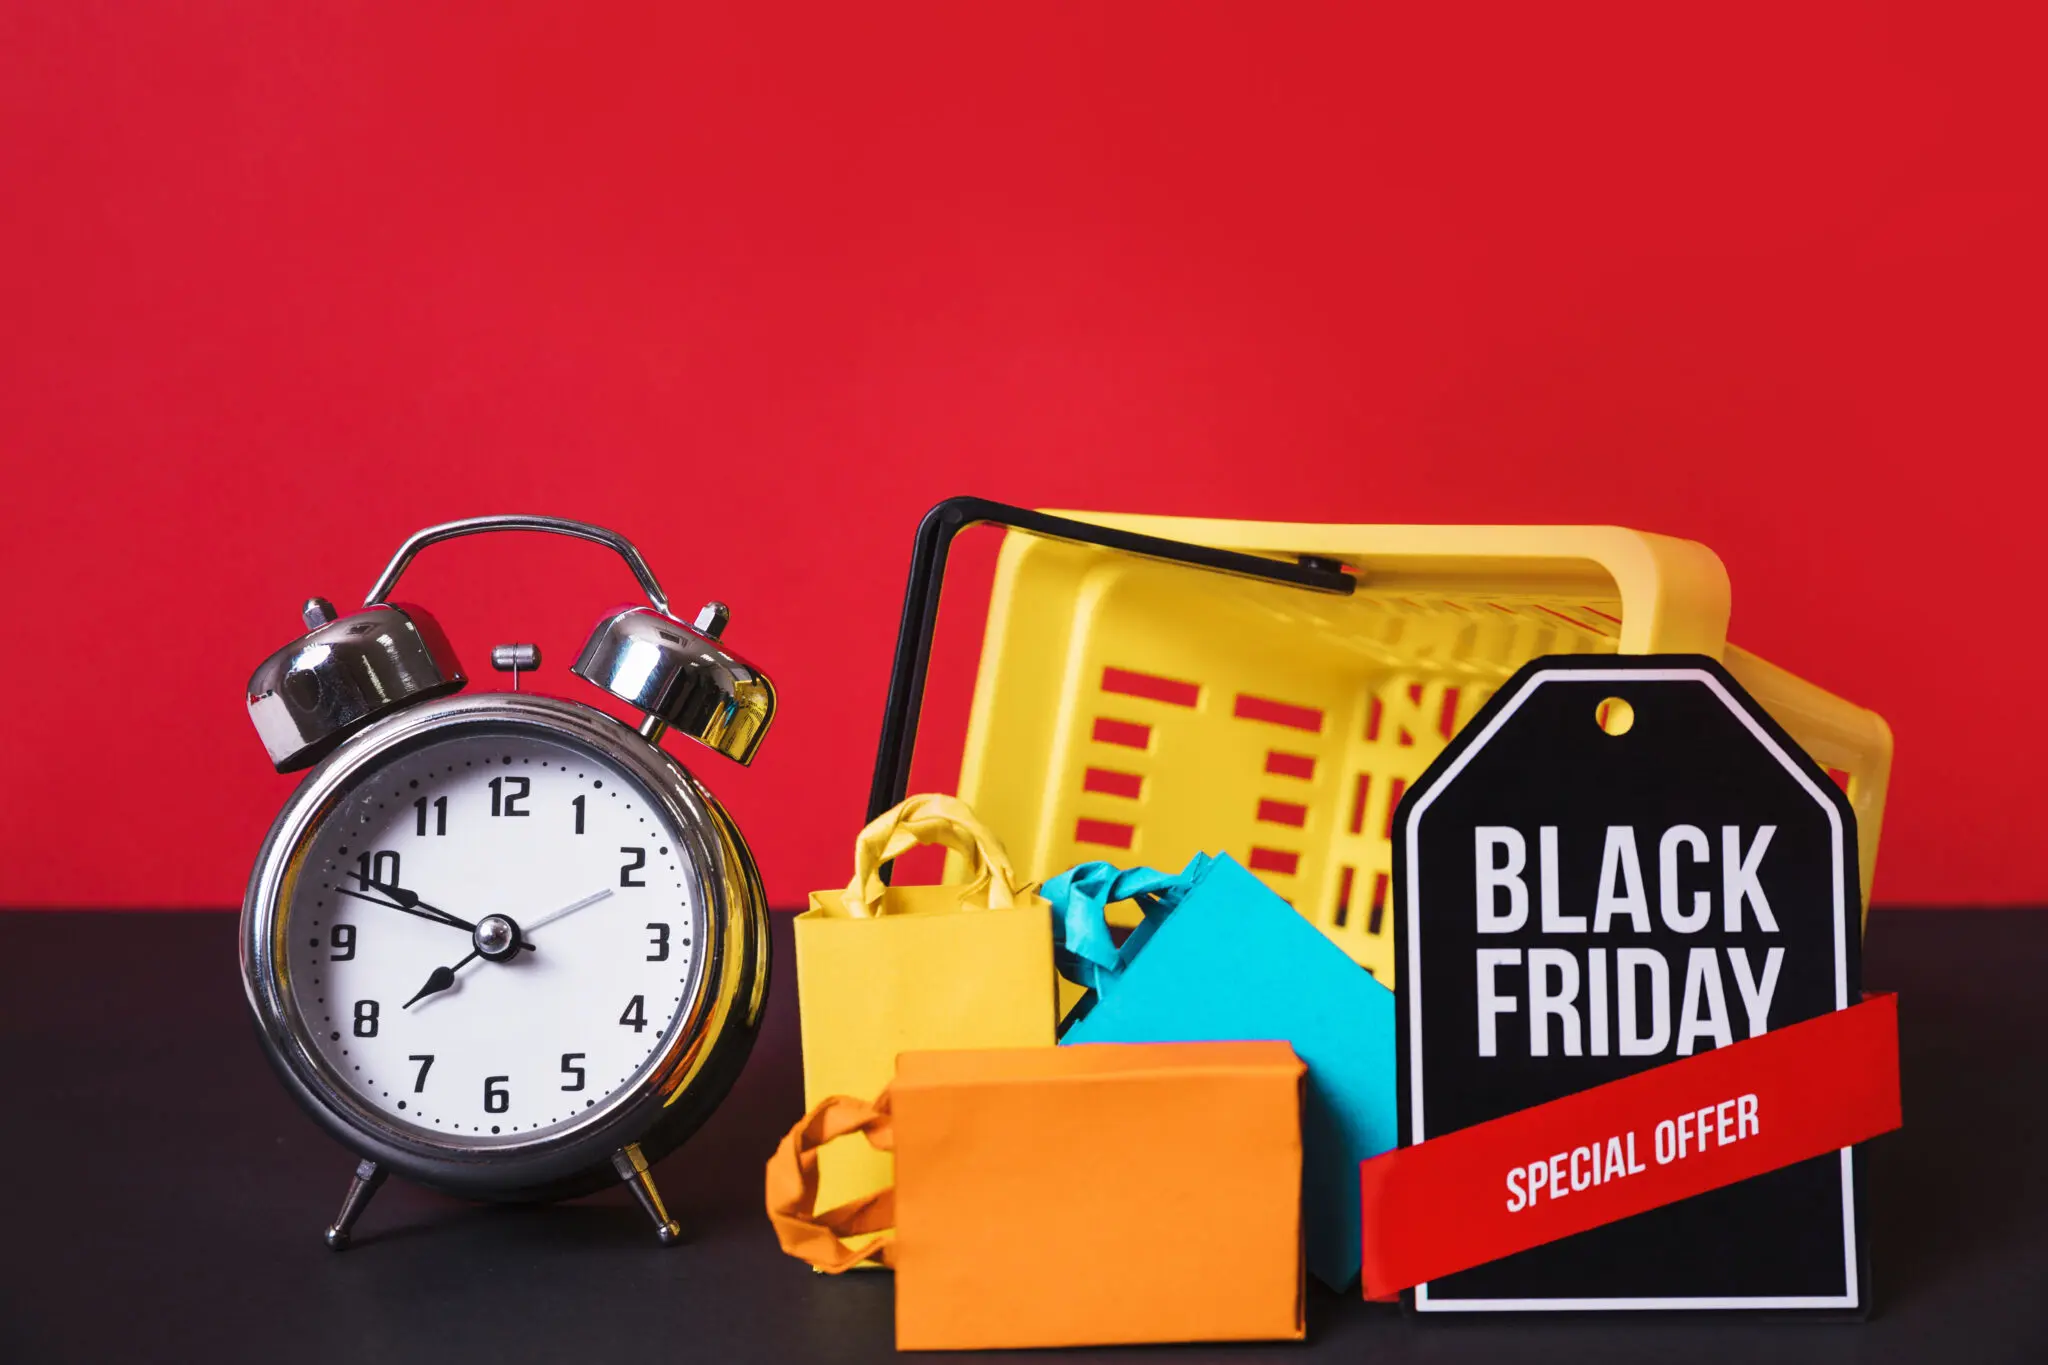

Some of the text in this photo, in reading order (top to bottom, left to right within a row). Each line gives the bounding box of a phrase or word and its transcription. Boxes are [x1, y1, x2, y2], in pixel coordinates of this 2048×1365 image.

[413, 796, 448, 836] 11
[488, 776, 530, 817] 12
[572, 794, 586, 834] 1
[356, 850, 401, 892] 10
[619, 846, 646, 887] 2
[1474, 824, 1780, 934] BLACK
[330, 924, 357, 962] 9
[646, 922, 670, 962] 3
[353, 999, 380, 1038] 8
[619, 994, 648, 1033] 4
[1475, 947, 1786, 1057] FRIDAY
[408, 1054, 435, 1093] 7
[560, 1052, 586, 1092] 5
[483, 1075, 510, 1114] 6
[1506, 1092, 1760, 1213] SPECIAL OFFER
